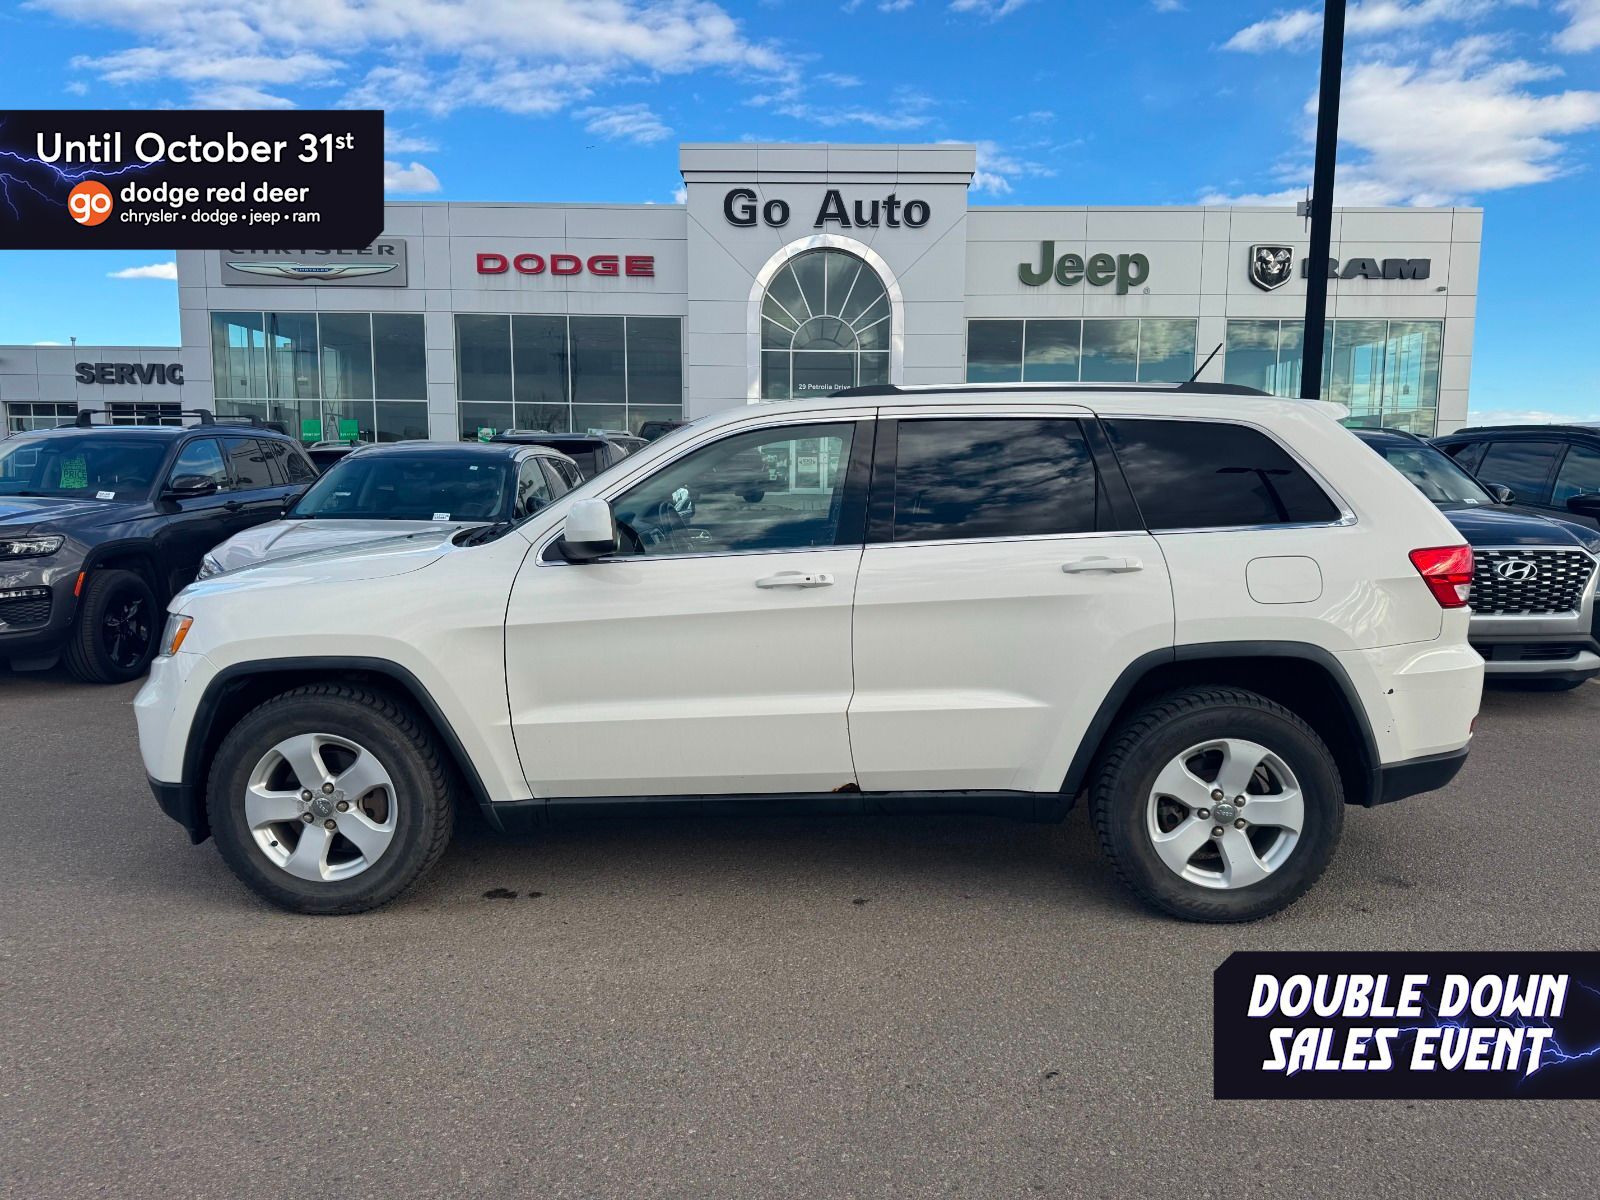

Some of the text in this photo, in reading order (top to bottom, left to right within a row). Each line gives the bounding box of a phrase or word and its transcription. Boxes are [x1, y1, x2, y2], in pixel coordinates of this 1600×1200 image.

[723, 187, 932, 228] Go Auto
[476, 253, 655, 277] DODGE
[1018, 240, 1150, 295] Jeep
